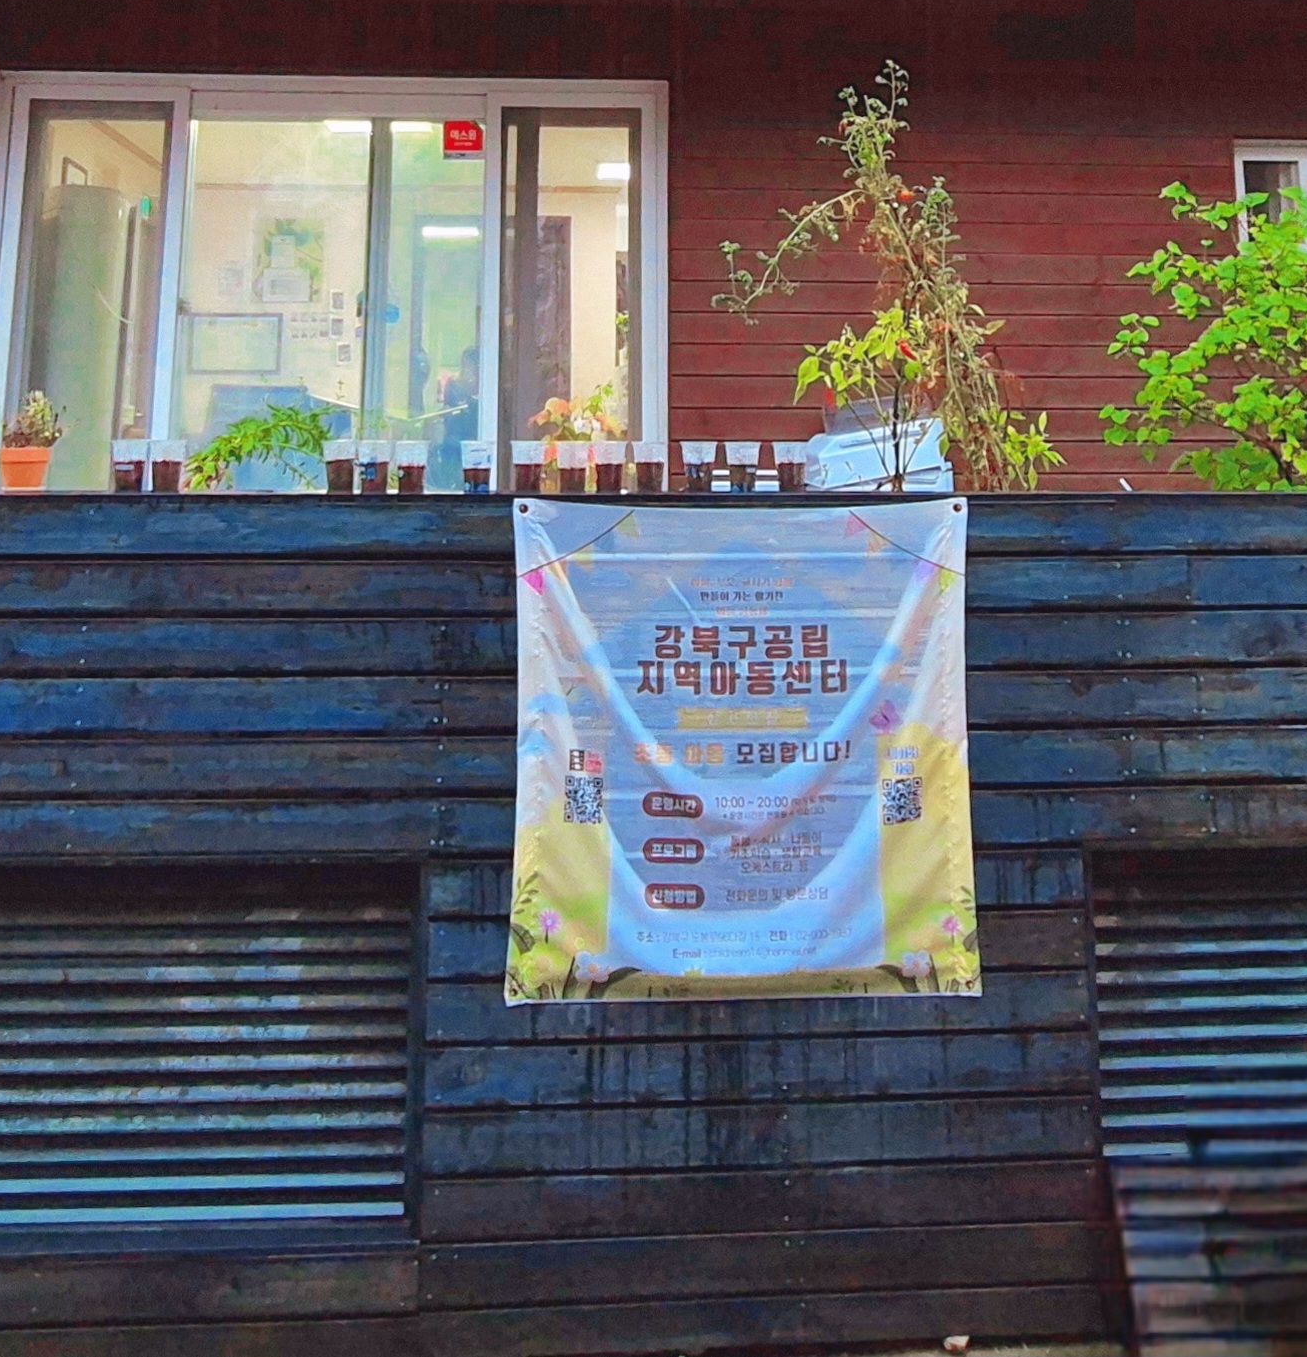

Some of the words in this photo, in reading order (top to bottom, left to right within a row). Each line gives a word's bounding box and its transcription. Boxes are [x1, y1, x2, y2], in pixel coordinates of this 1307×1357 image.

[654, 624, 829, 659] 강북구공립
[637, 658, 848, 695] 지역아동센터
[736, 740, 852, 765] 모집합니다!
[651, 797, 697, 813] 운영시간
[714, 796, 744, 809] 10:00
[757, 796, 788, 808] 20:00
[651, 843, 697, 859] 프로그램
